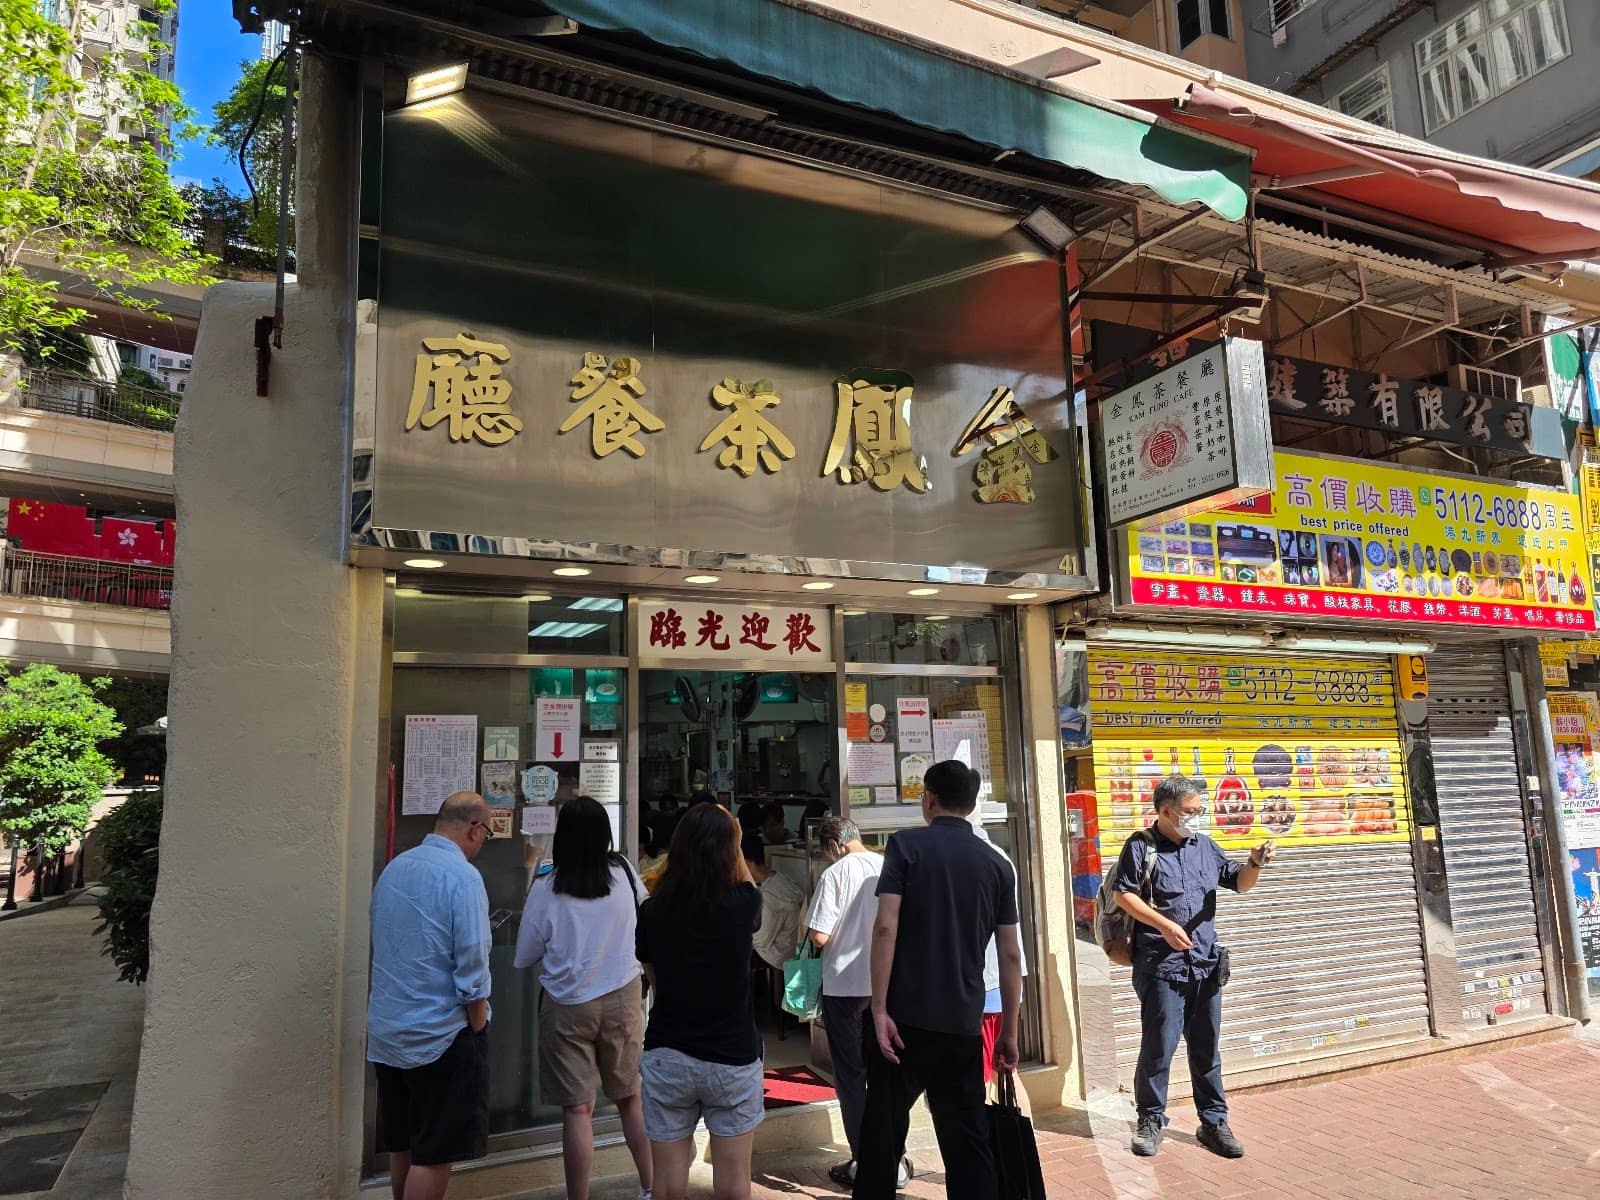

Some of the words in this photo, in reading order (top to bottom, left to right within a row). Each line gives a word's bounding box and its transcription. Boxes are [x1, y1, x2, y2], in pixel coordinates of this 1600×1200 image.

[1284, 473, 1417, 520] 高價收購
[1434, 488, 1542, 531] 5112-6888
[1300, 514, 1327, 529] best
[1333, 519, 1362, 532] price
[1369, 523, 1408, 537] offered
[1058, 554, 1078, 575] 41
[1097, 661, 1223, 702] 高價收購
[1105, 709, 1134, 725] best
[1141, 709, 1172, 727] price
[1180, 709, 1222, 725] offered
